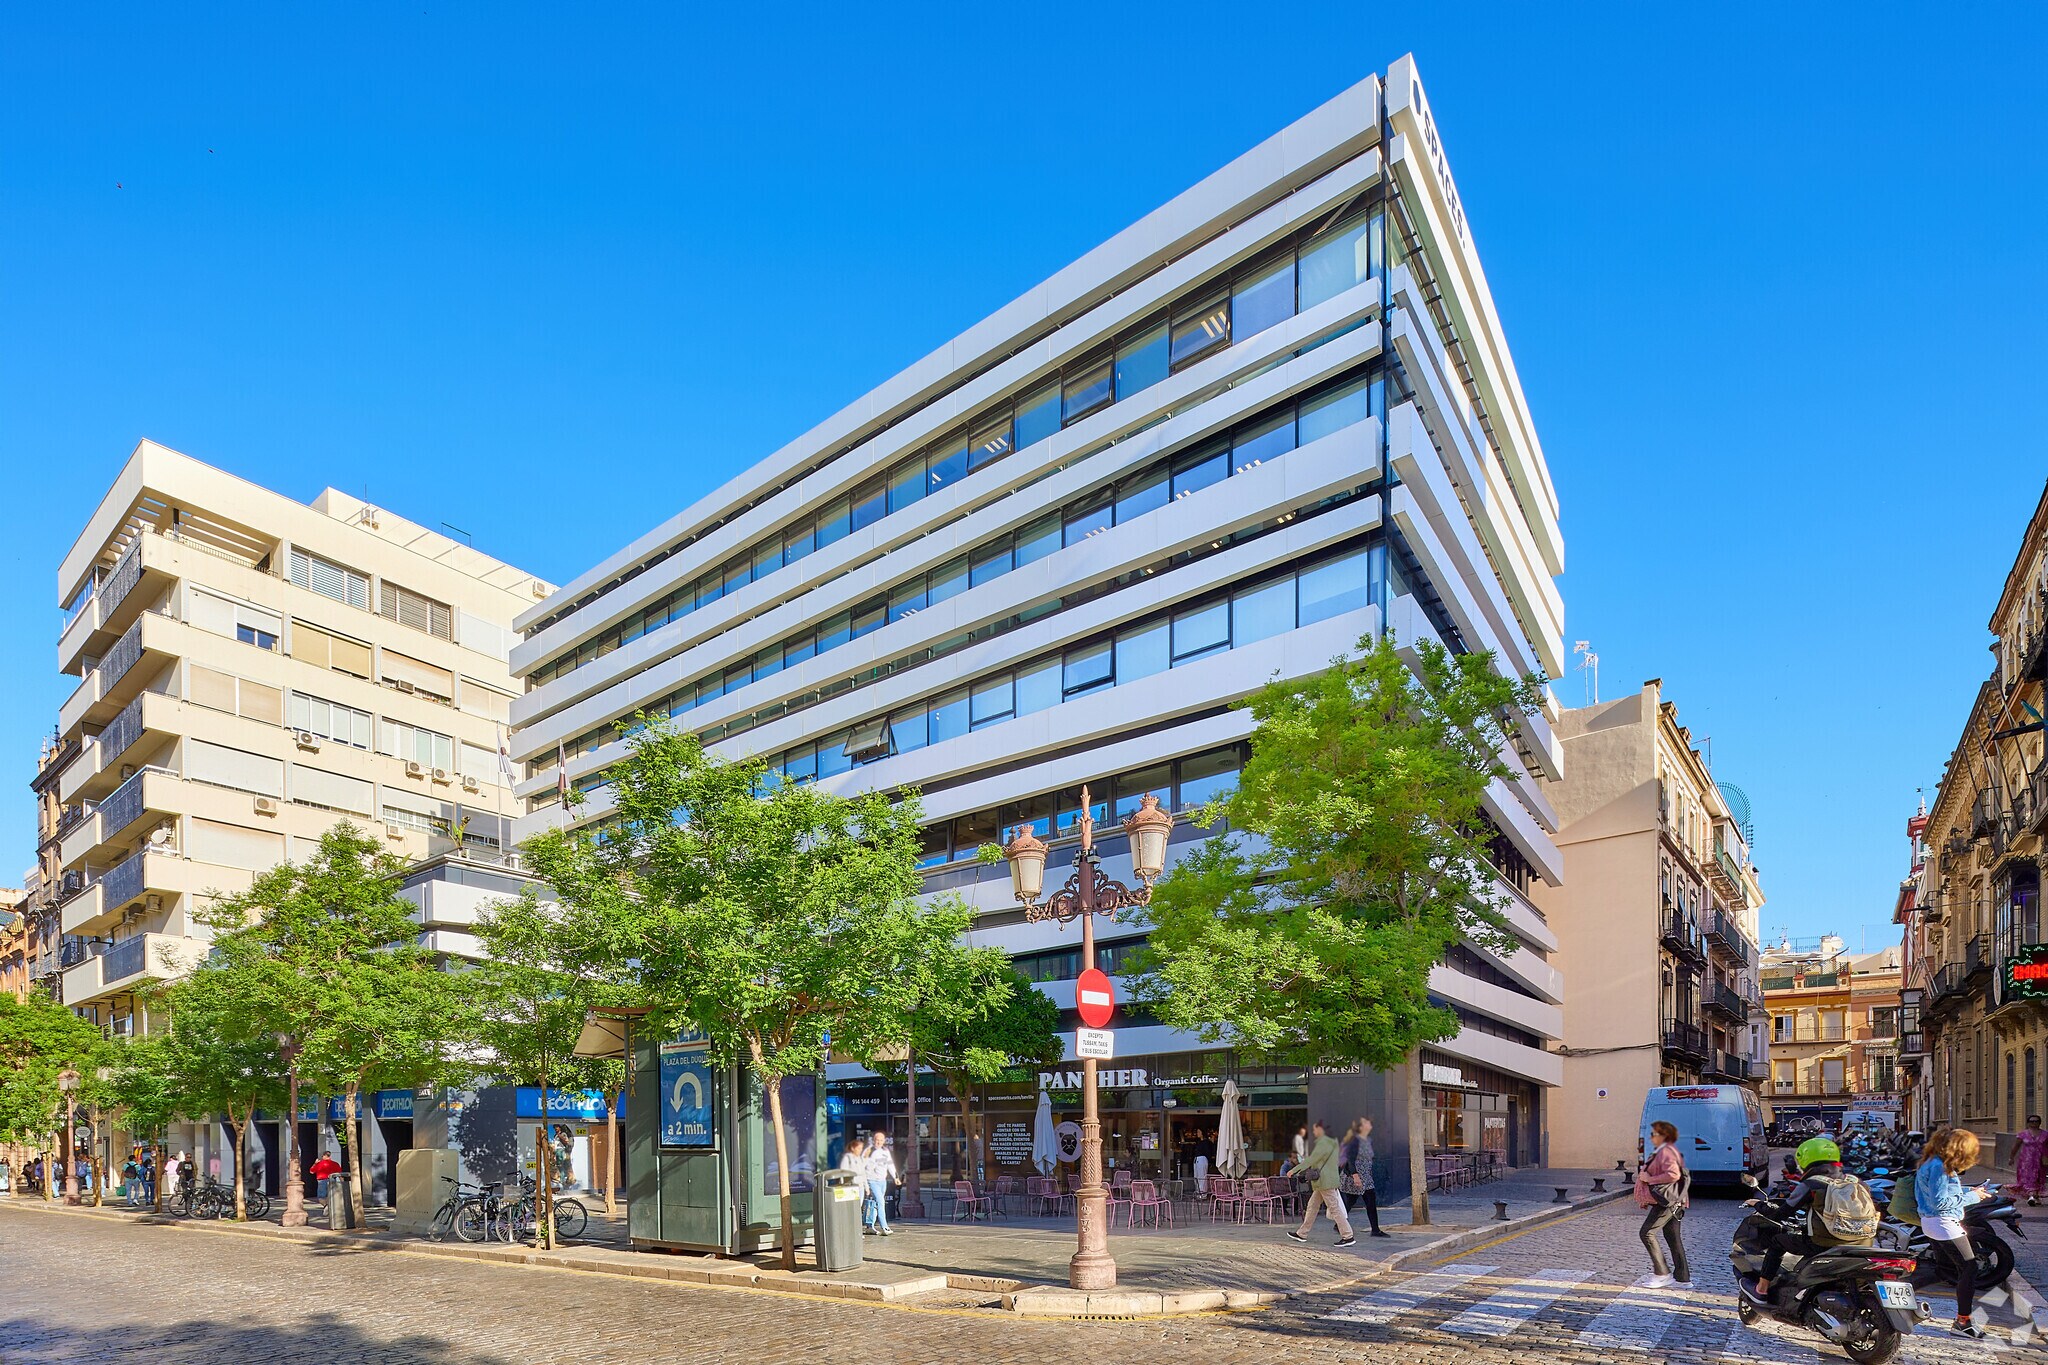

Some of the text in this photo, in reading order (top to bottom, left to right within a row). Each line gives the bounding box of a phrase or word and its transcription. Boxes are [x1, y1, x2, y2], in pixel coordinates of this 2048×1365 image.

[663, 1057, 679, 1066] PLAZA
[680, 1056, 690, 1065] DEL
[1038, 1068, 1219, 1089] PANHER Organic Coffee
[667, 1120, 707, 1135] a 2 min.
[1886, 1286, 1912, 1297] 7478
[1889, 1296, 1909, 1306] LTS
